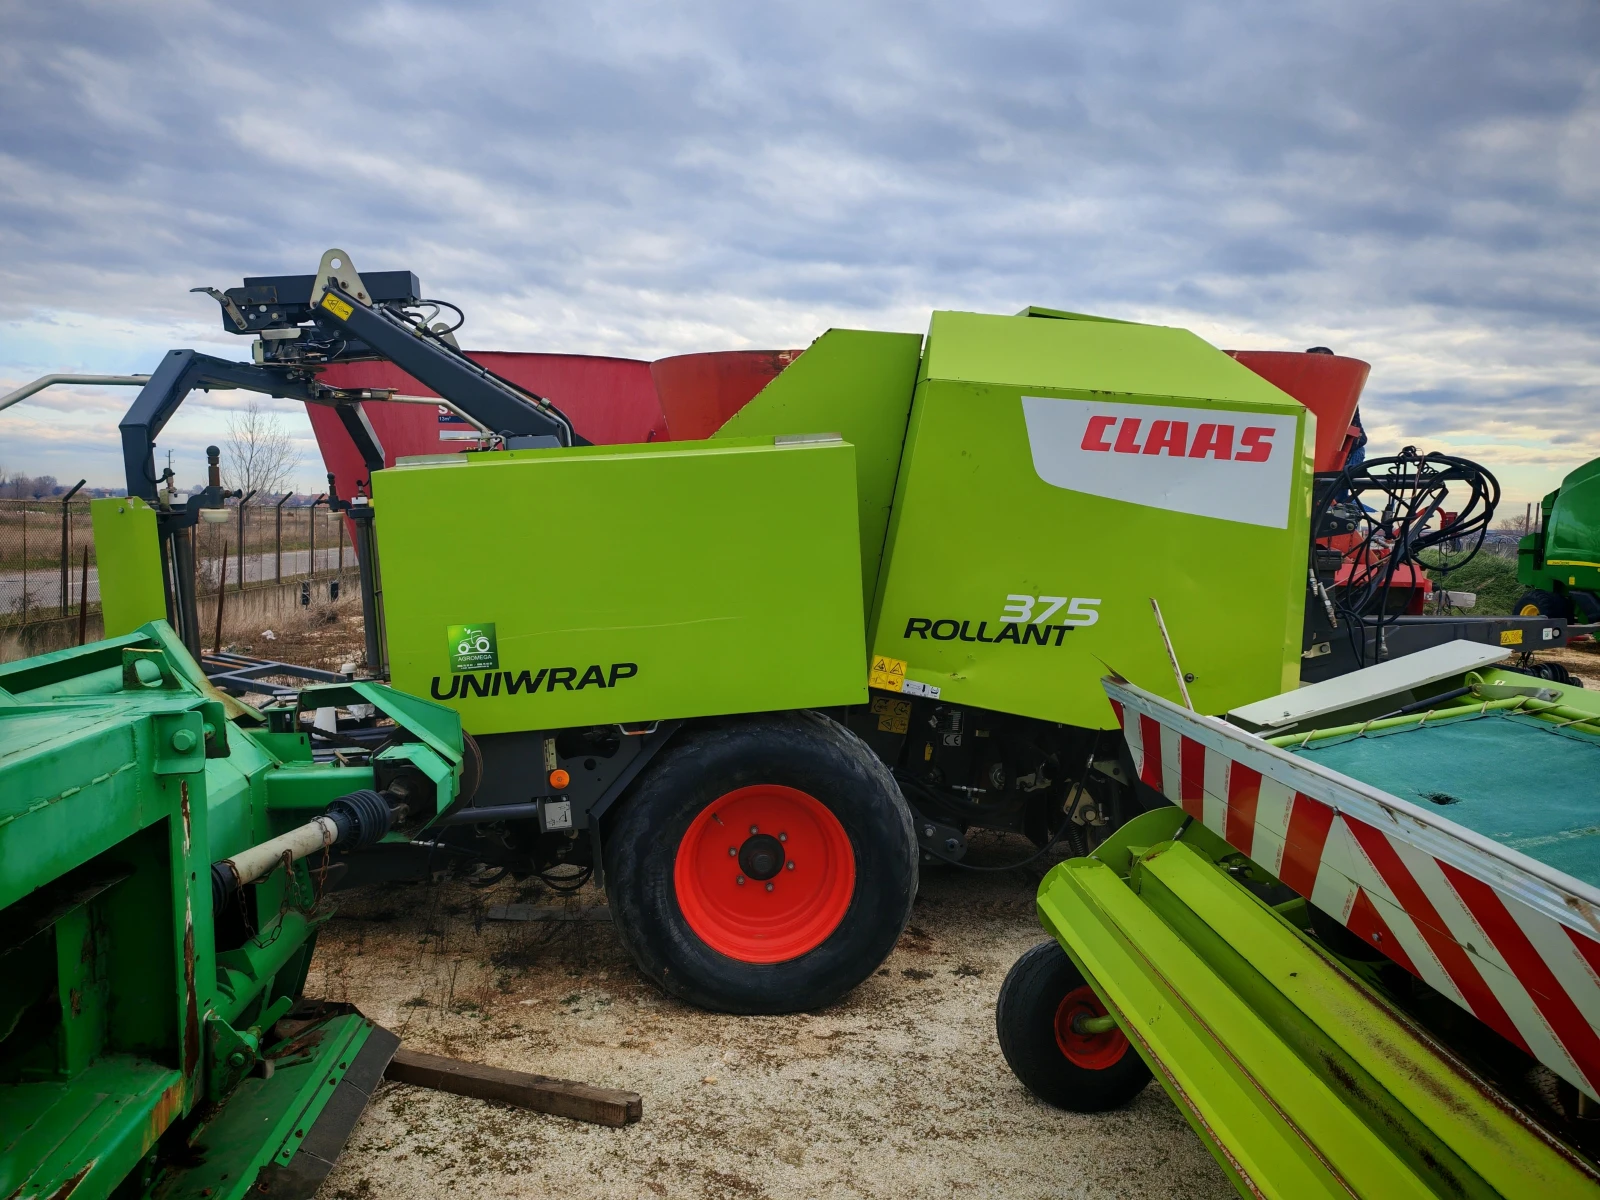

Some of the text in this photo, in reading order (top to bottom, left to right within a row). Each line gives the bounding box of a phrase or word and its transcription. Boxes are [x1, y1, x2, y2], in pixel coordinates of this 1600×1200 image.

[1080, 415, 1276, 462] CLAAS
[999, 594, 1102, 627] 375
[903, 617, 1075, 646] ROLLANT
[458, 654, 492, 662] AGROMEGA
[430, 662, 638, 700] UNIWRAP
